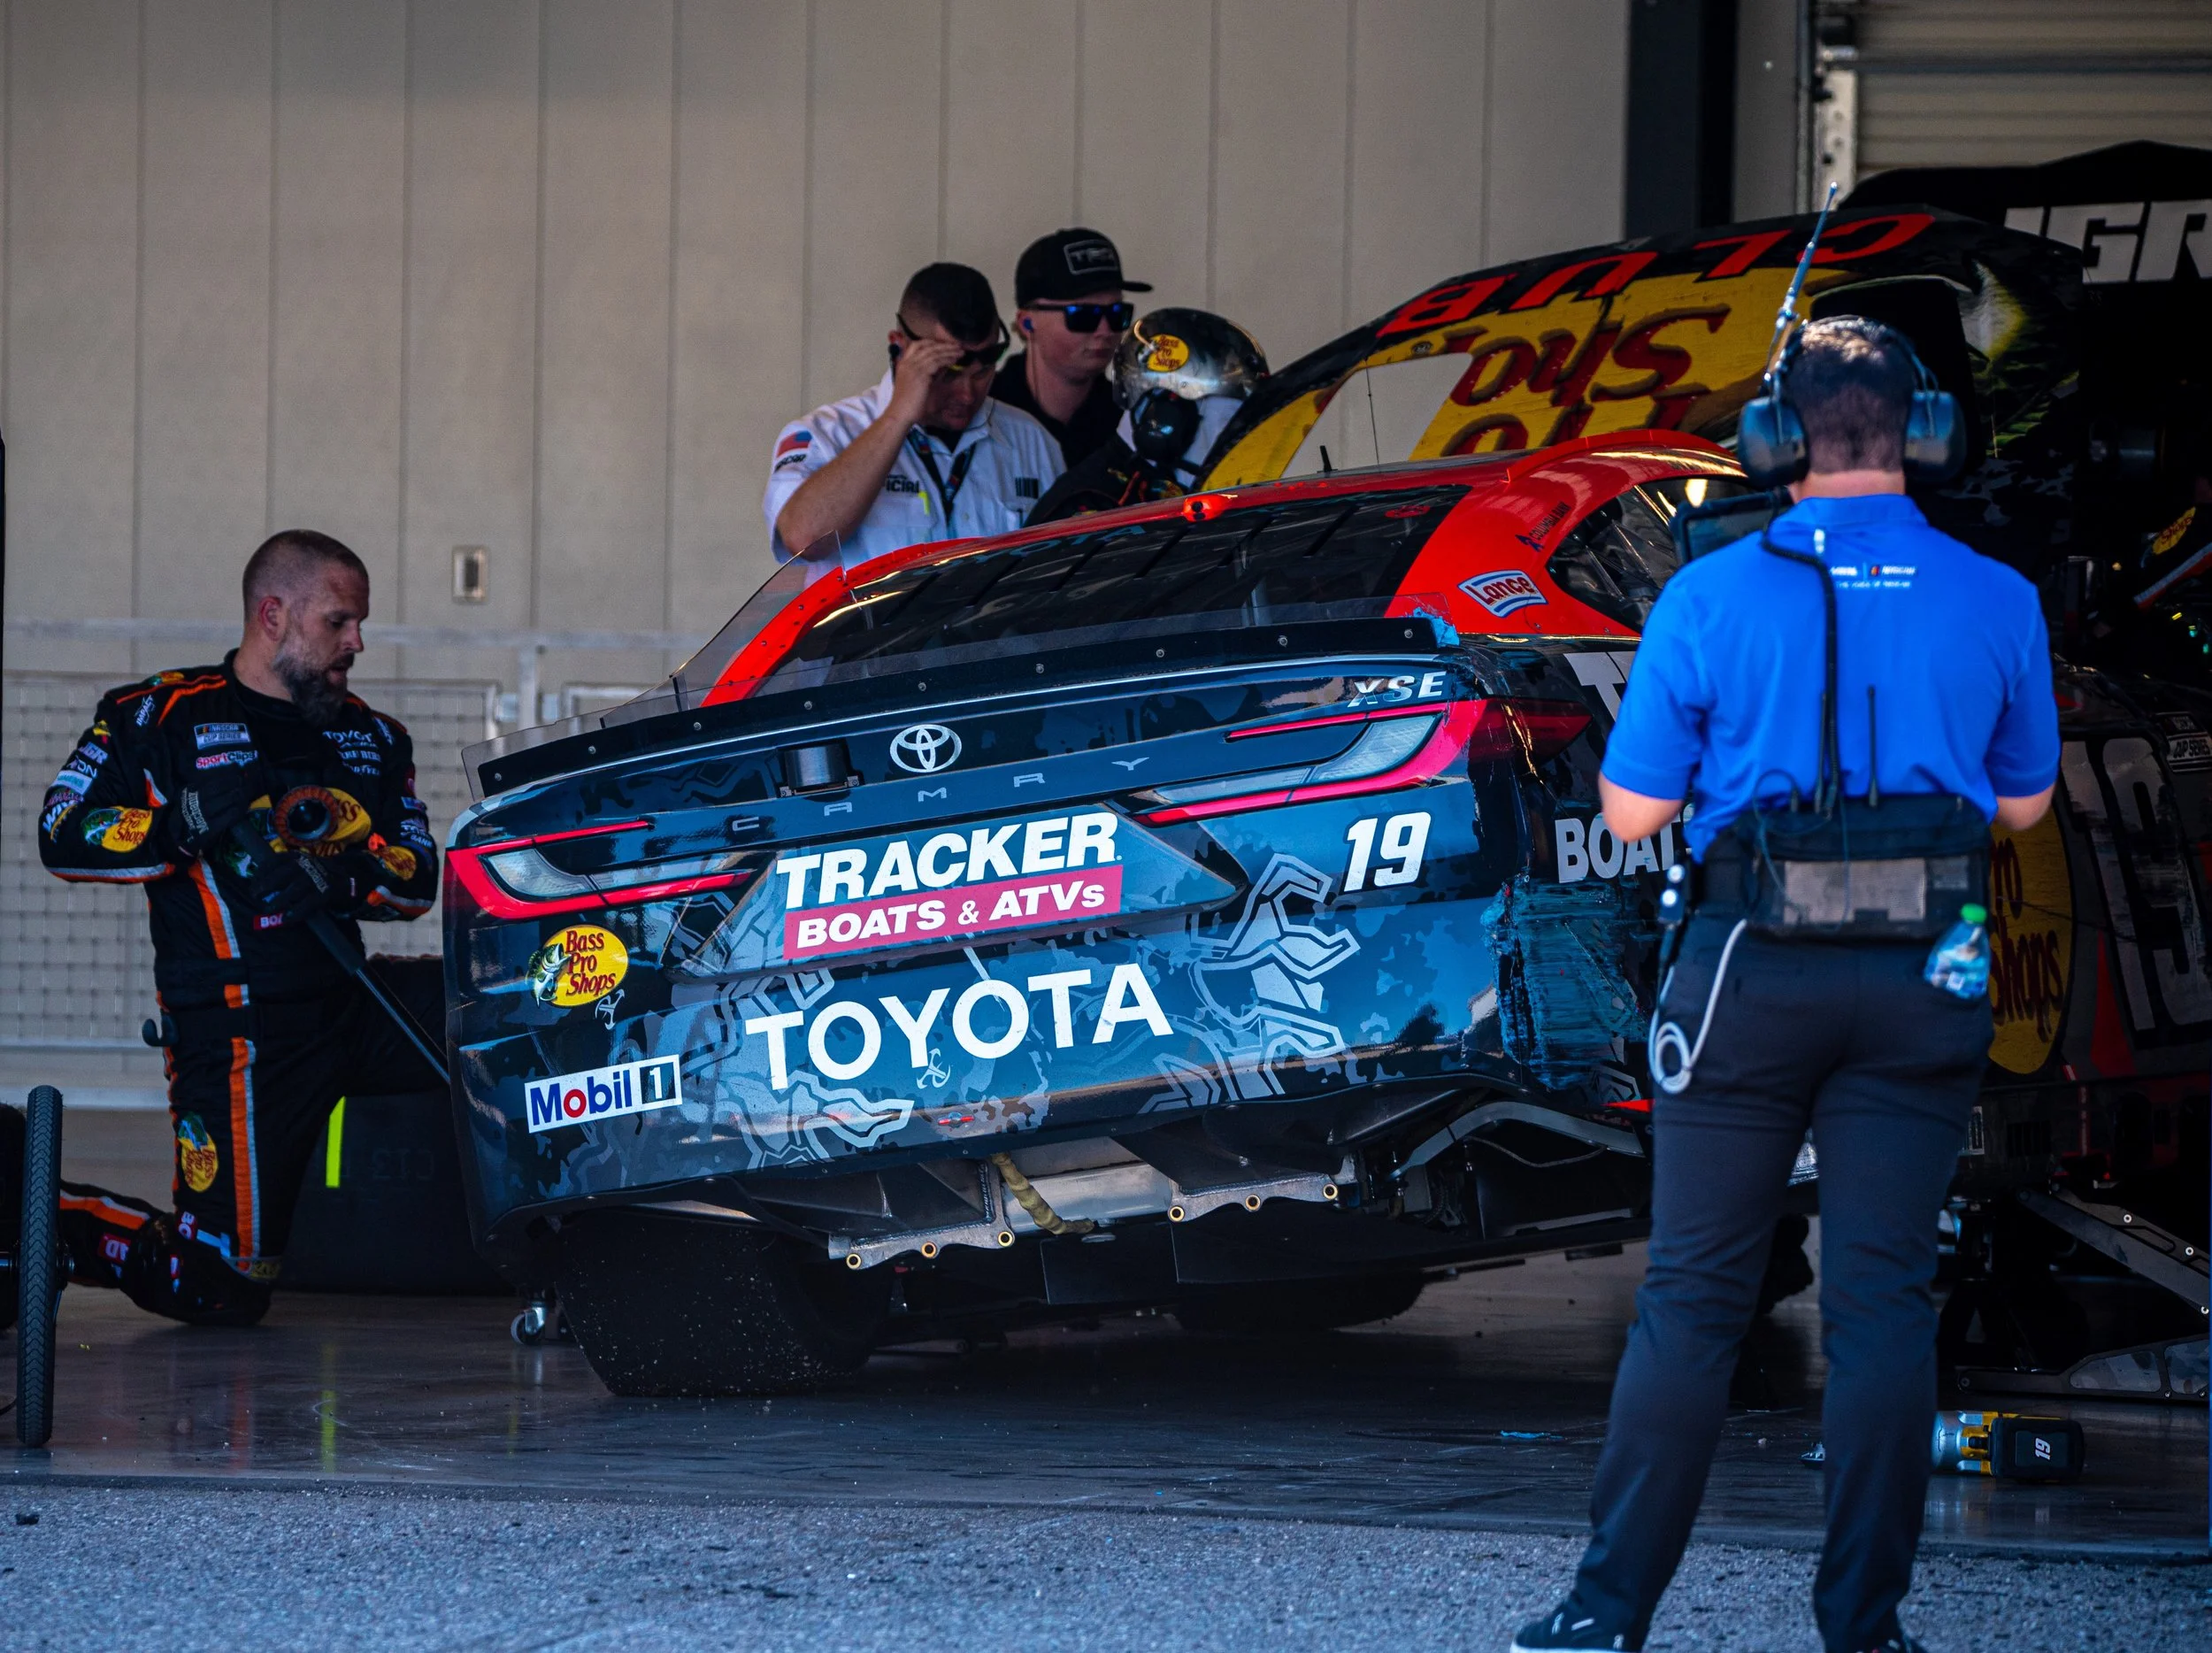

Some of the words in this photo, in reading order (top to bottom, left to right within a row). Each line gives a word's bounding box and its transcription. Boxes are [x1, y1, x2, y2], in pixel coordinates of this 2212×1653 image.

[1375, 213, 1935, 338] CLUB
[1479, 573, 1534, 609] Lance
[1348, 672, 1447, 708] XSE
[322, 729, 373, 743] TOYOT
[732, 757, 1149, 831] CAMRY
[119, 817, 139, 830] Pro
[776, 811, 1120, 910] TRACKER
[1344, 812, 1431, 892] 19
[1992, 837, 2023, 918] ro
[565, 930, 606, 953] Bass
[797, 899, 944, 949] BOATS
[956, 901, 979, 925] &
[565, 970, 617, 997] Shops
[568, 952, 598, 975] Pro
[745, 963, 1173, 1091] TOYOTA
[530, 1069, 633, 1126] Mobil
[647, 1065, 664, 1102] 1
[2035, 1437, 2051, 1460] 19
